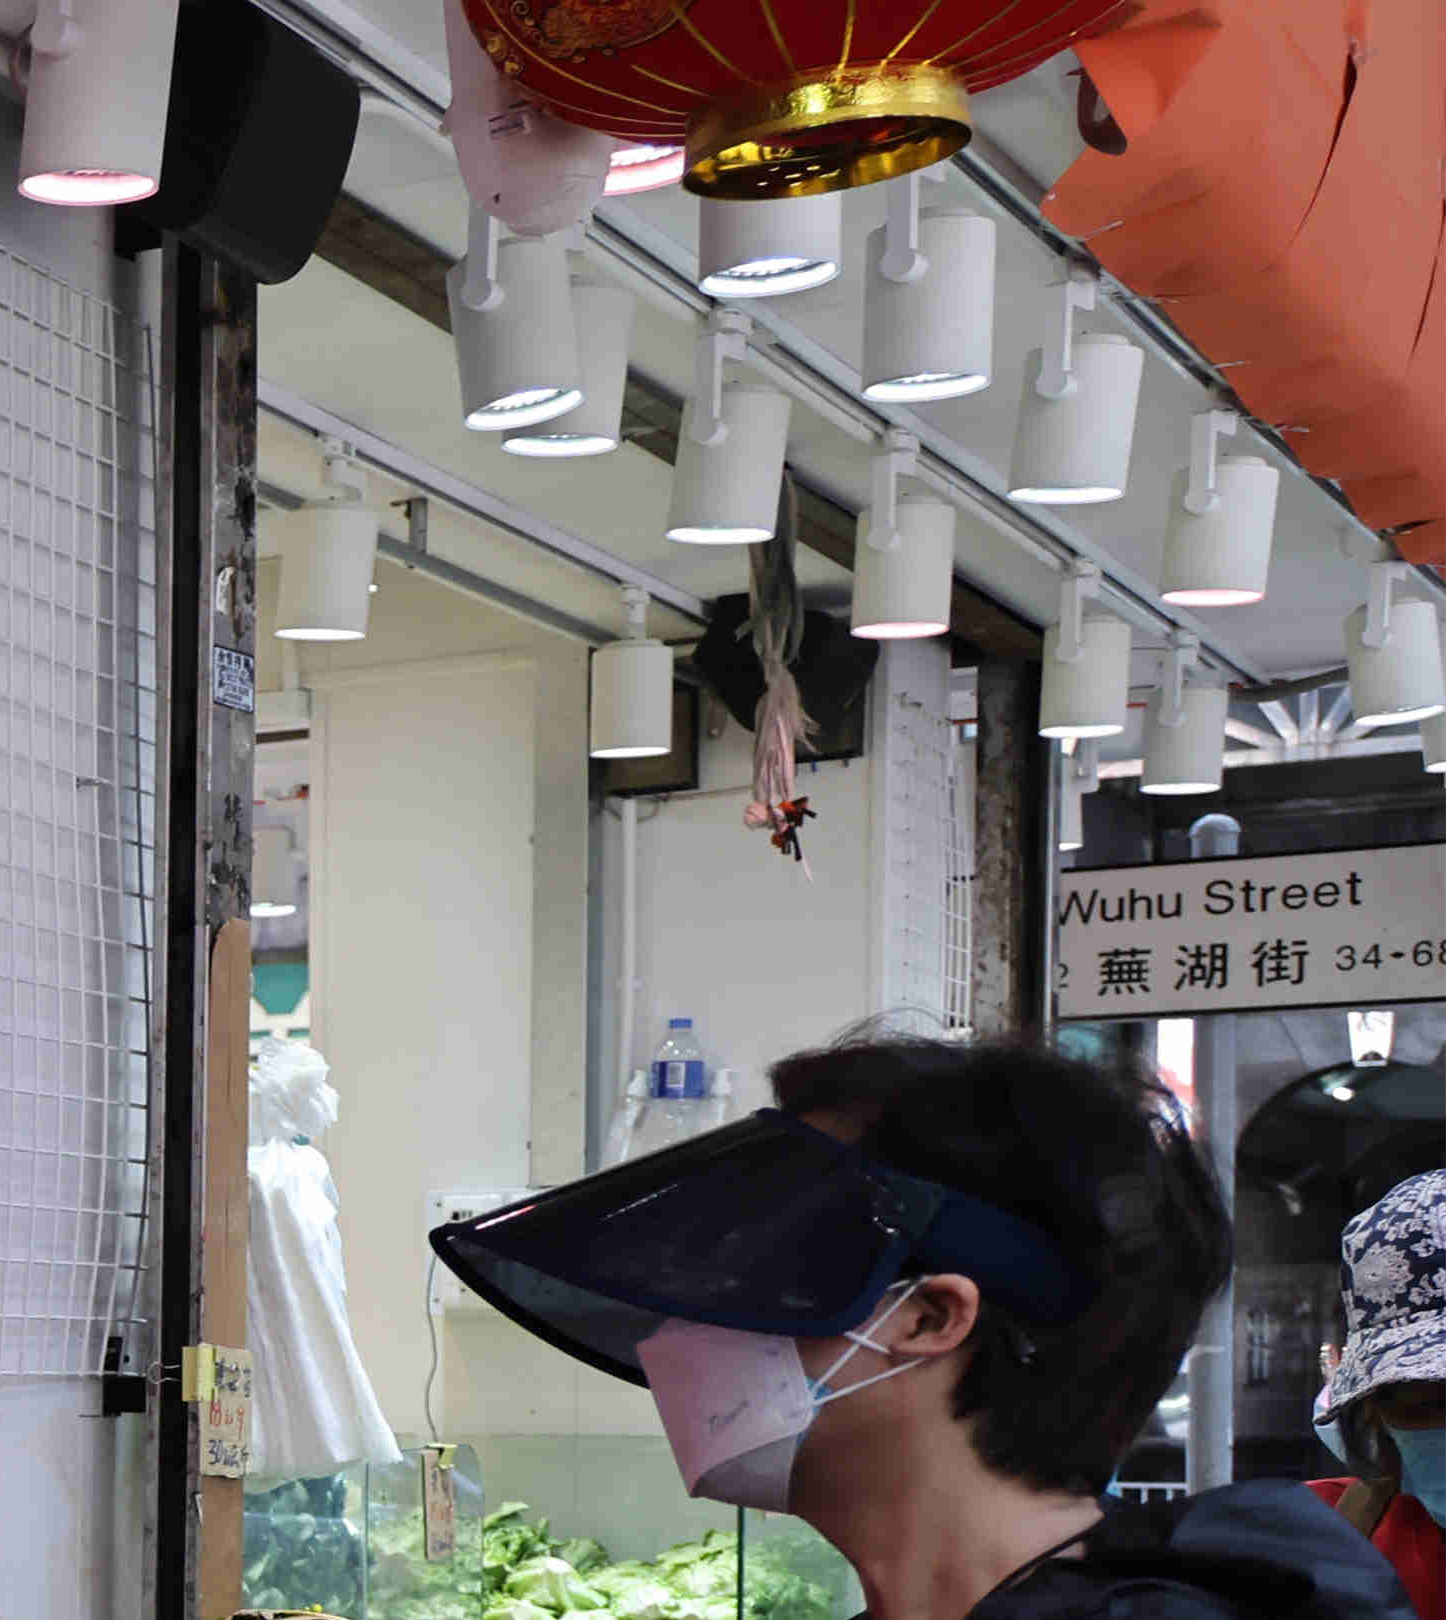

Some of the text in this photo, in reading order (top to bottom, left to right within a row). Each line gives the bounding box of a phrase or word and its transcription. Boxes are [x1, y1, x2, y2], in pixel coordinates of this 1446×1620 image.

[1060, 871, 1363, 926] Wuhu Street
[1097, 938, 1310, 997] 蕪湖街
